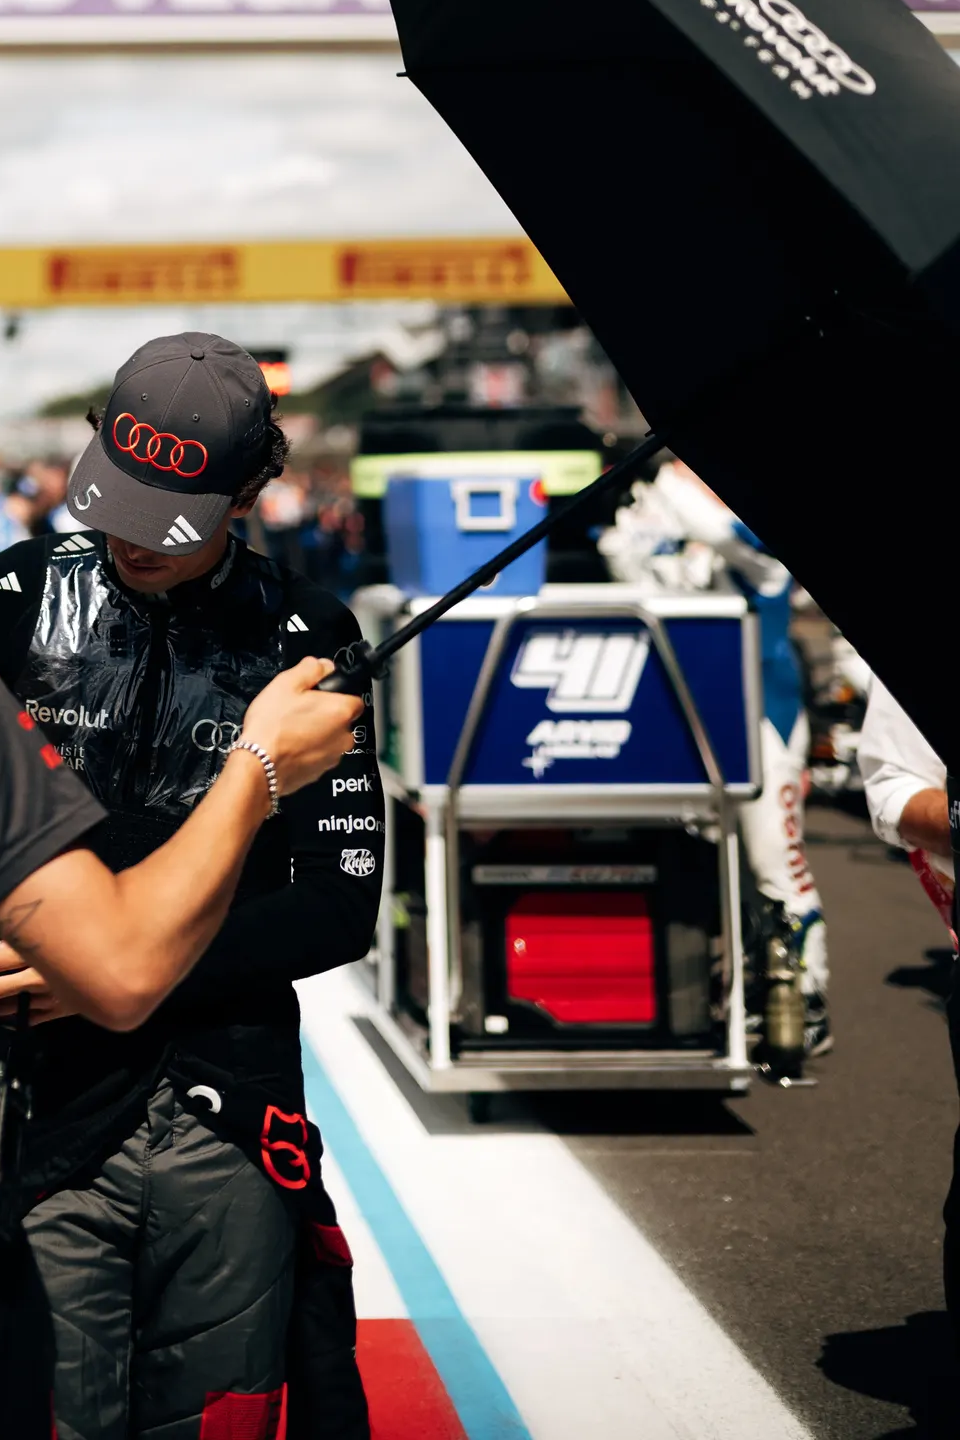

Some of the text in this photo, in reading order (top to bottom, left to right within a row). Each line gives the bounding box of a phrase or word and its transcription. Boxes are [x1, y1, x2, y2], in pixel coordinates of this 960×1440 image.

[74, 483, 102, 510] 5
[25, 699, 109, 729] Revolut
[53, 743, 85, 758] visit
[332, 774, 373, 797] perk
[343, 849, 374, 875] KitKat
